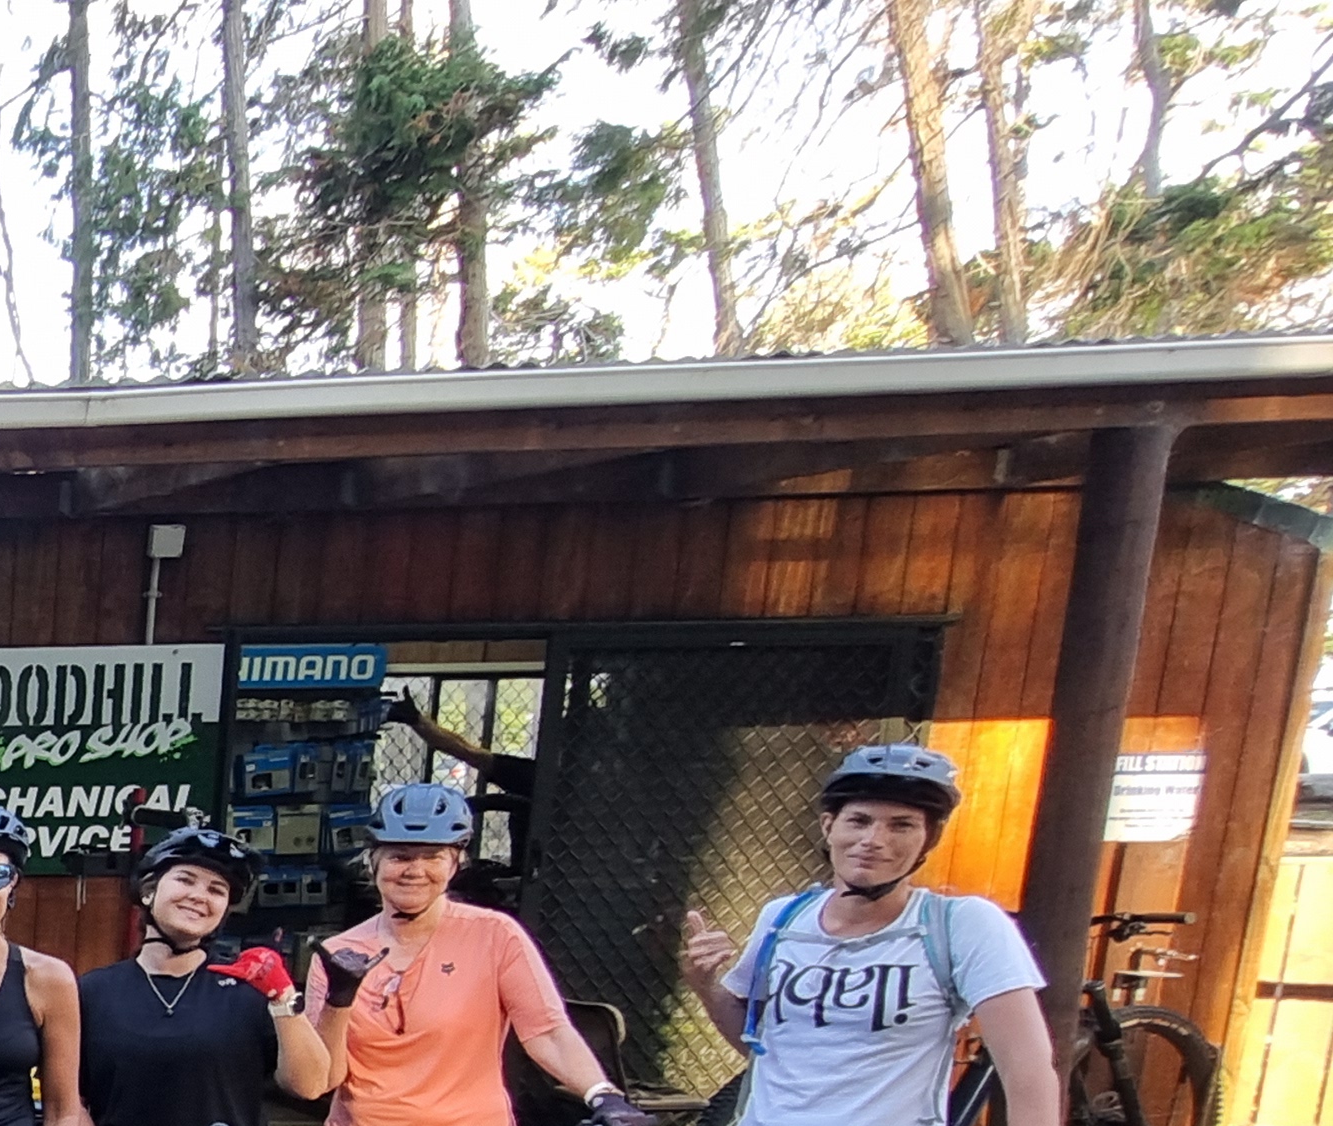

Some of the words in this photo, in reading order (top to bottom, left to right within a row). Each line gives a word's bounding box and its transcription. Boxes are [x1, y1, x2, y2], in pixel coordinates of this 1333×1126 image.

[239, 654, 376, 682] IMANO
[0, 730, 82, 771] PRO
[79, 718, 193, 763] SHOP
[27, 825, 132, 858] VICE
